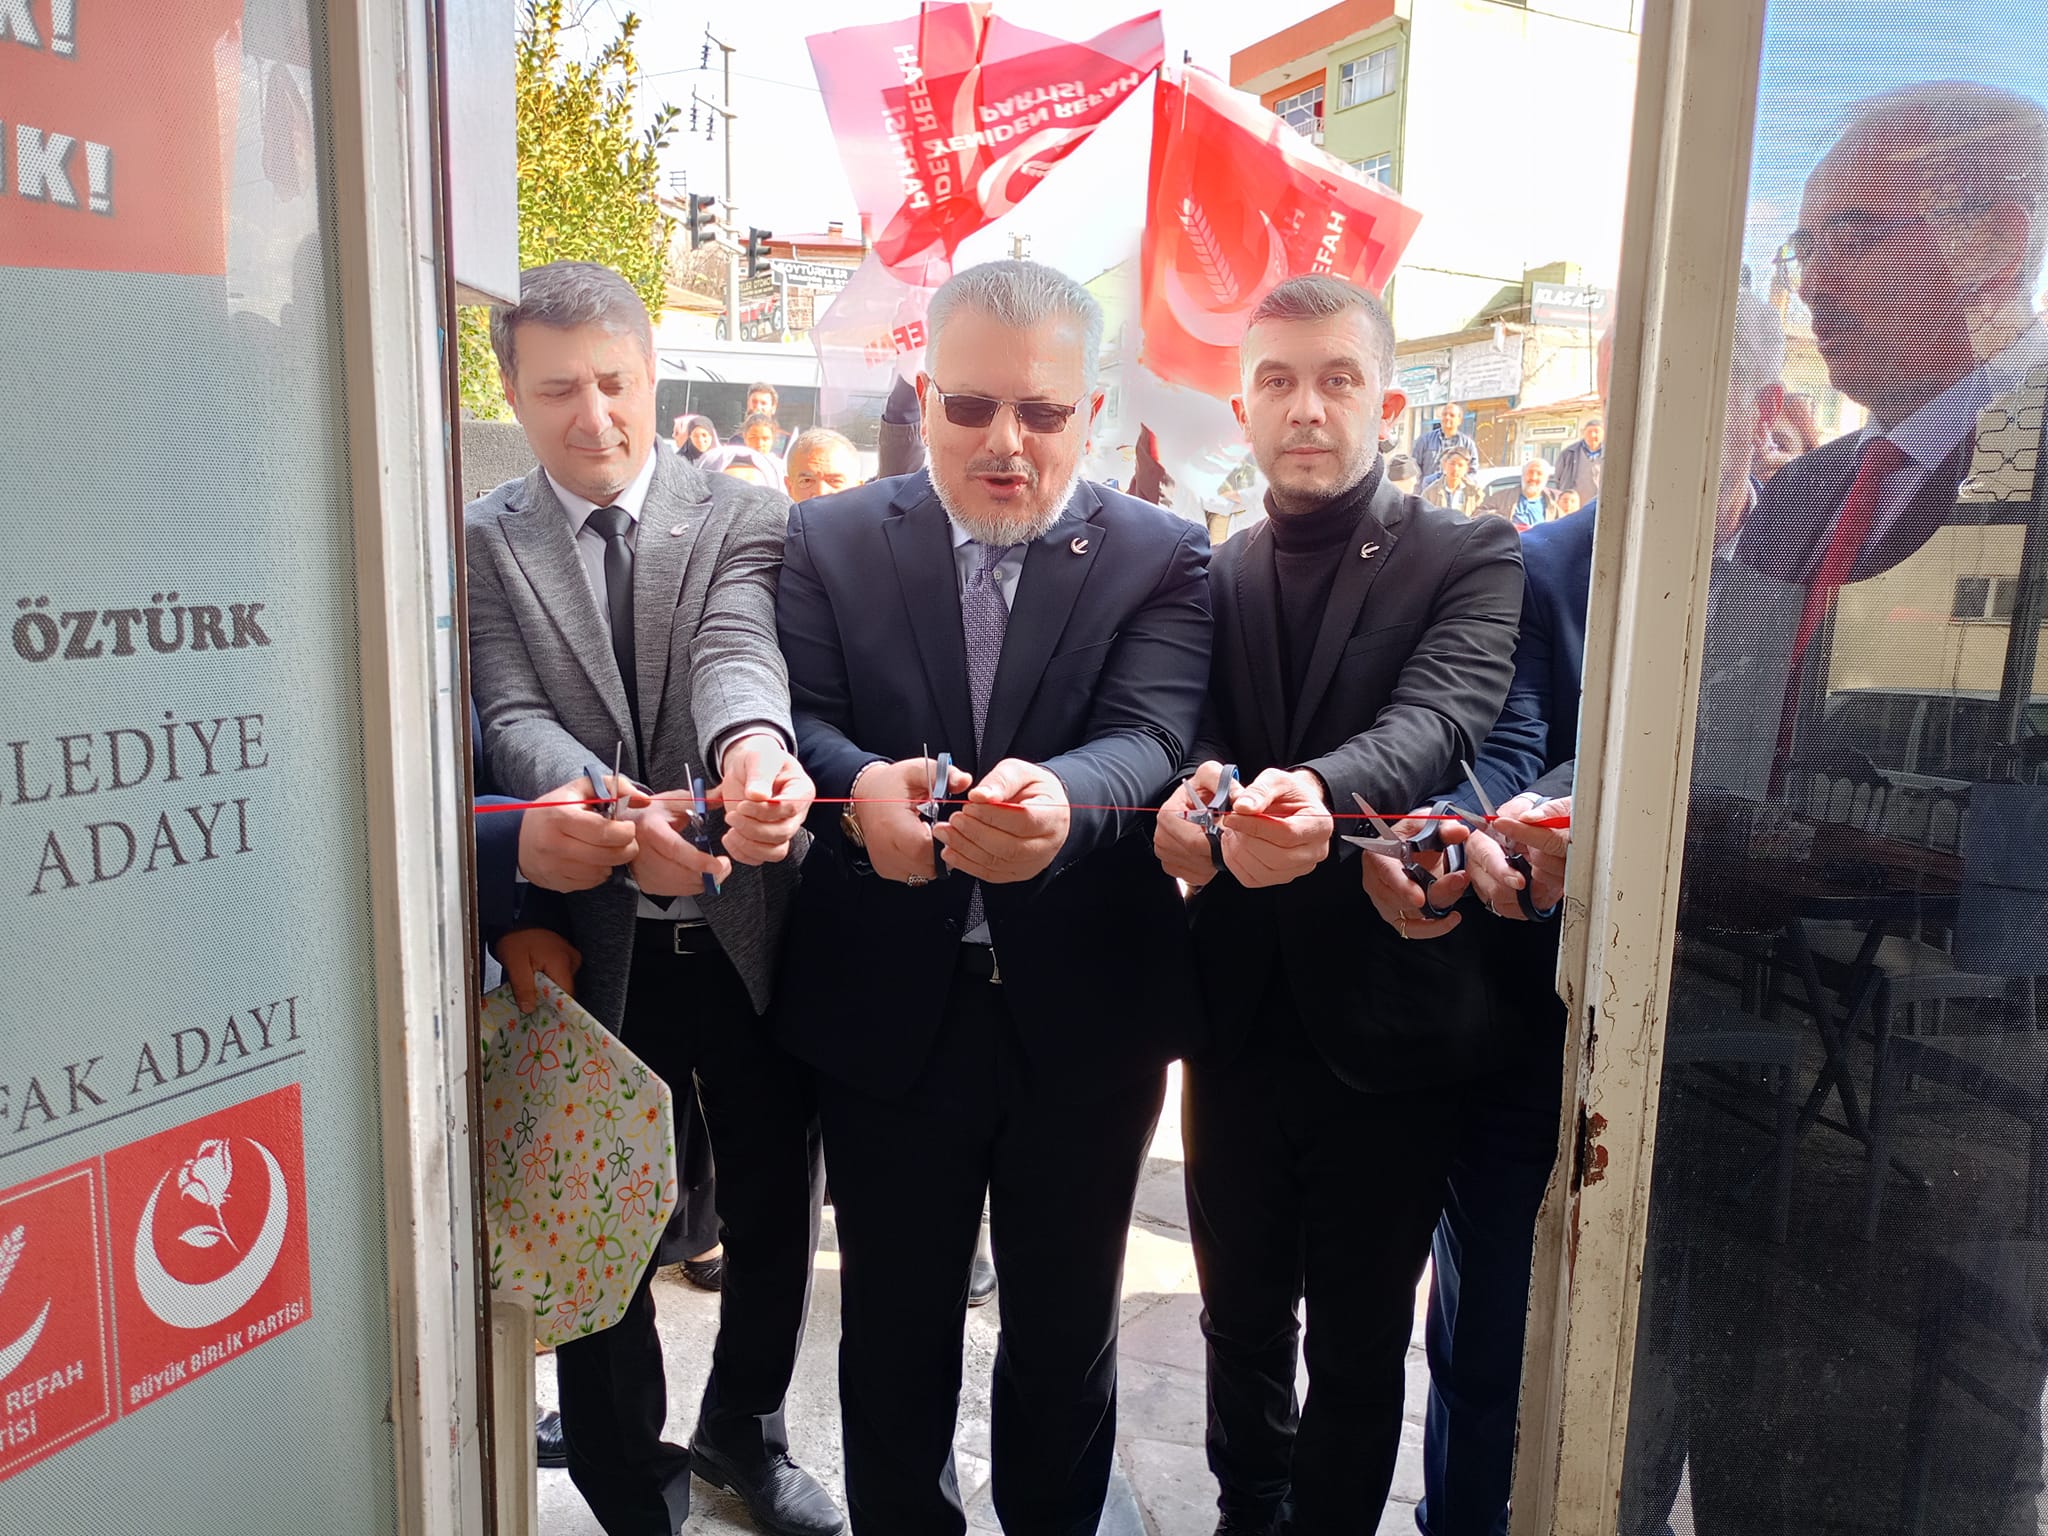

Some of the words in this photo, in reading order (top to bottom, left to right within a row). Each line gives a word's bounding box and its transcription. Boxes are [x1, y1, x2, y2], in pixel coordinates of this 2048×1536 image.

[0, 121, 114, 214] K!
[12, 591, 272, 663] ÖZTÜRK
[0, 711, 270, 805] LEDİYE
[28, 798, 253, 896] ADAYI
[127, 995, 302, 1096] ADAYI
[5, 1359, 84, 1415] REFAH
[130, 1360, 188, 1404] BÜYÜK
[190, 1331, 244, 1374] BİRLİK
[247, 1297, 305, 1343] PARTİSİ
